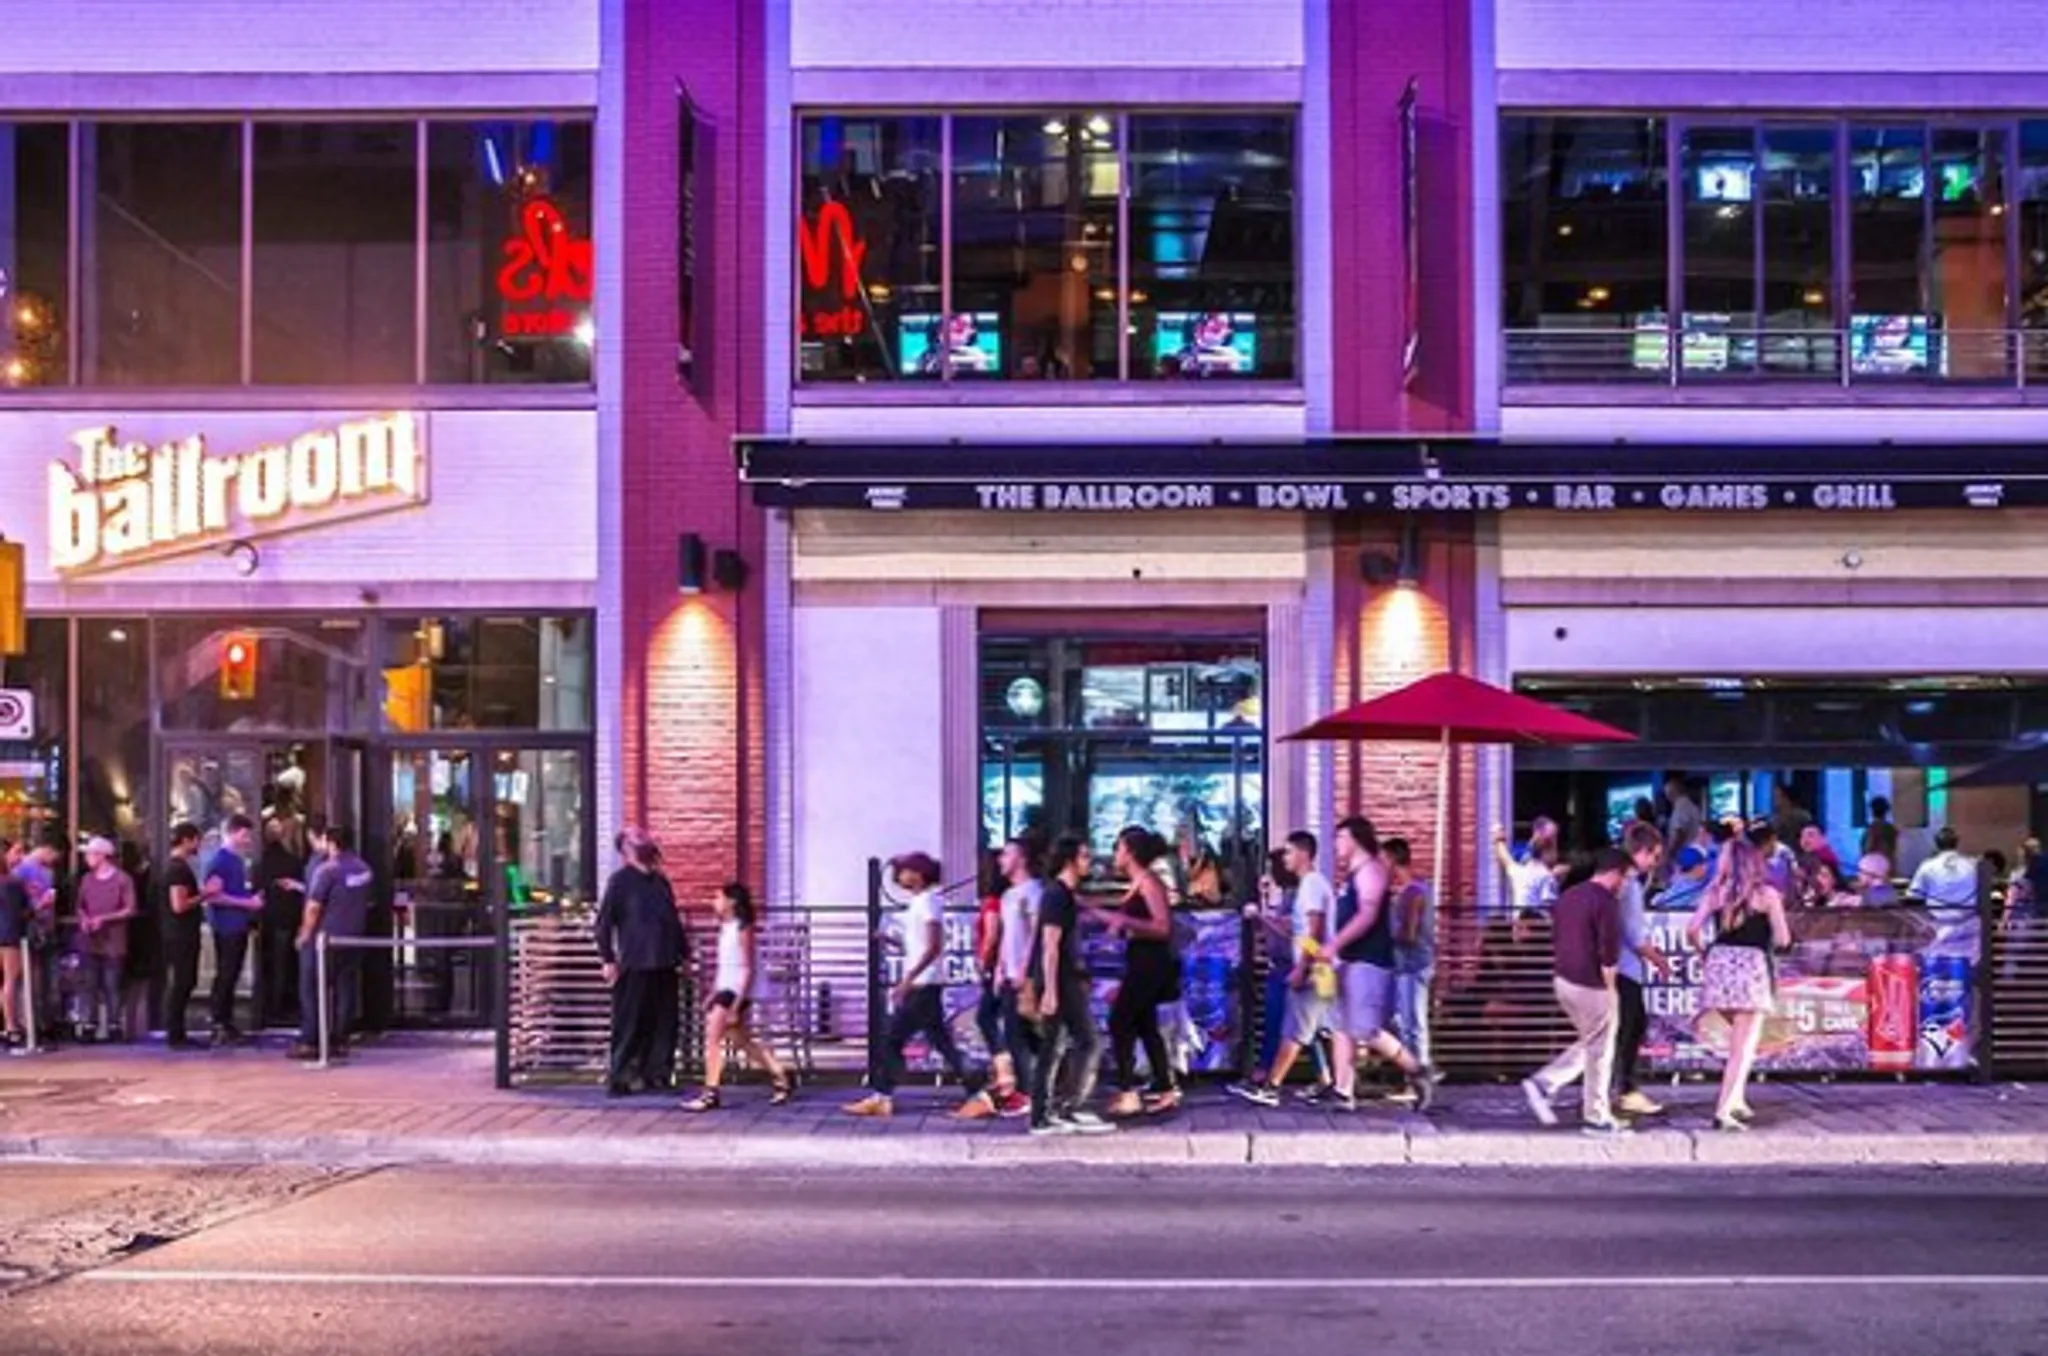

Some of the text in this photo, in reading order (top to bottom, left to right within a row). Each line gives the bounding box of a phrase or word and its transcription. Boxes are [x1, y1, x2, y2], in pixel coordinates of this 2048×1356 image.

[71, 426, 150, 483] The
[48, 411, 417, 569] ballroom
[977, 485, 1896, 509] THE BALLROOM BOWL SPORTS BAR GAMES GRILL
